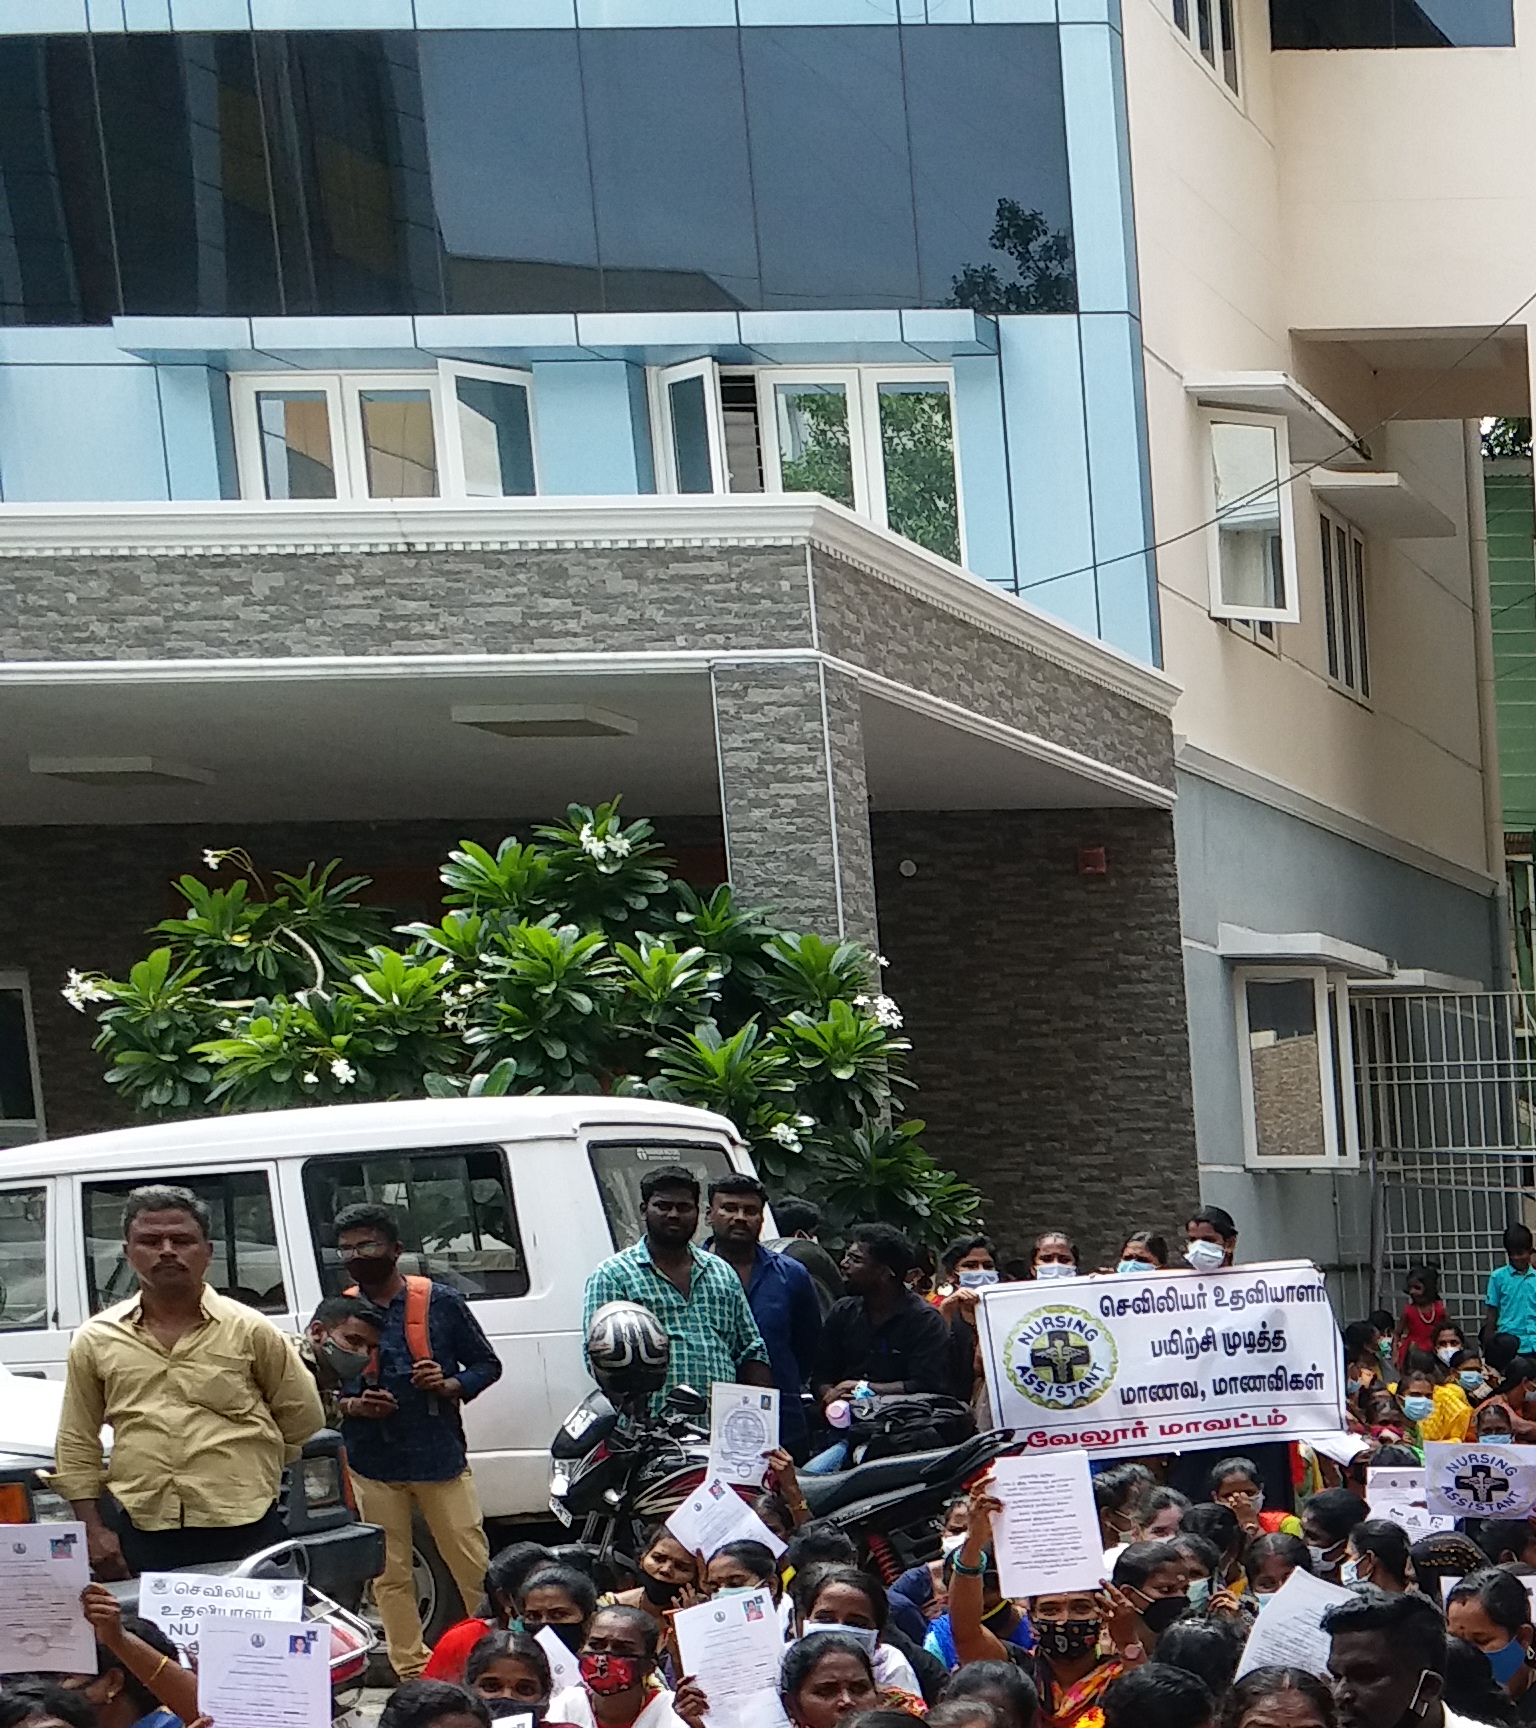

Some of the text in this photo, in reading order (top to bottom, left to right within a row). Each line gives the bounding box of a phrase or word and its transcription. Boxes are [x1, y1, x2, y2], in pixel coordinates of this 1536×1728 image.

[1100, 1280, 1326, 1317] செவிலியர் உதவியாளர்
[1017, 1316, 1099, 1346] NURSING
[1151, 1322, 1287, 1359] பயிற்சி முடித்த
[1016, 1362, 1107, 1399] ASSISTANT
[1121, 1364, 1324, 1405] மாணவ, மாணவிகள்
[1027, 1409, 1287, 1448] வேலூர் மாவட்டம்
[1446, 1453, 1517, 1477] NURSING
[1441, 1485, 1521, 1512] ASSISTANT
[174, 1582, 261, 1600] செவிலிய
